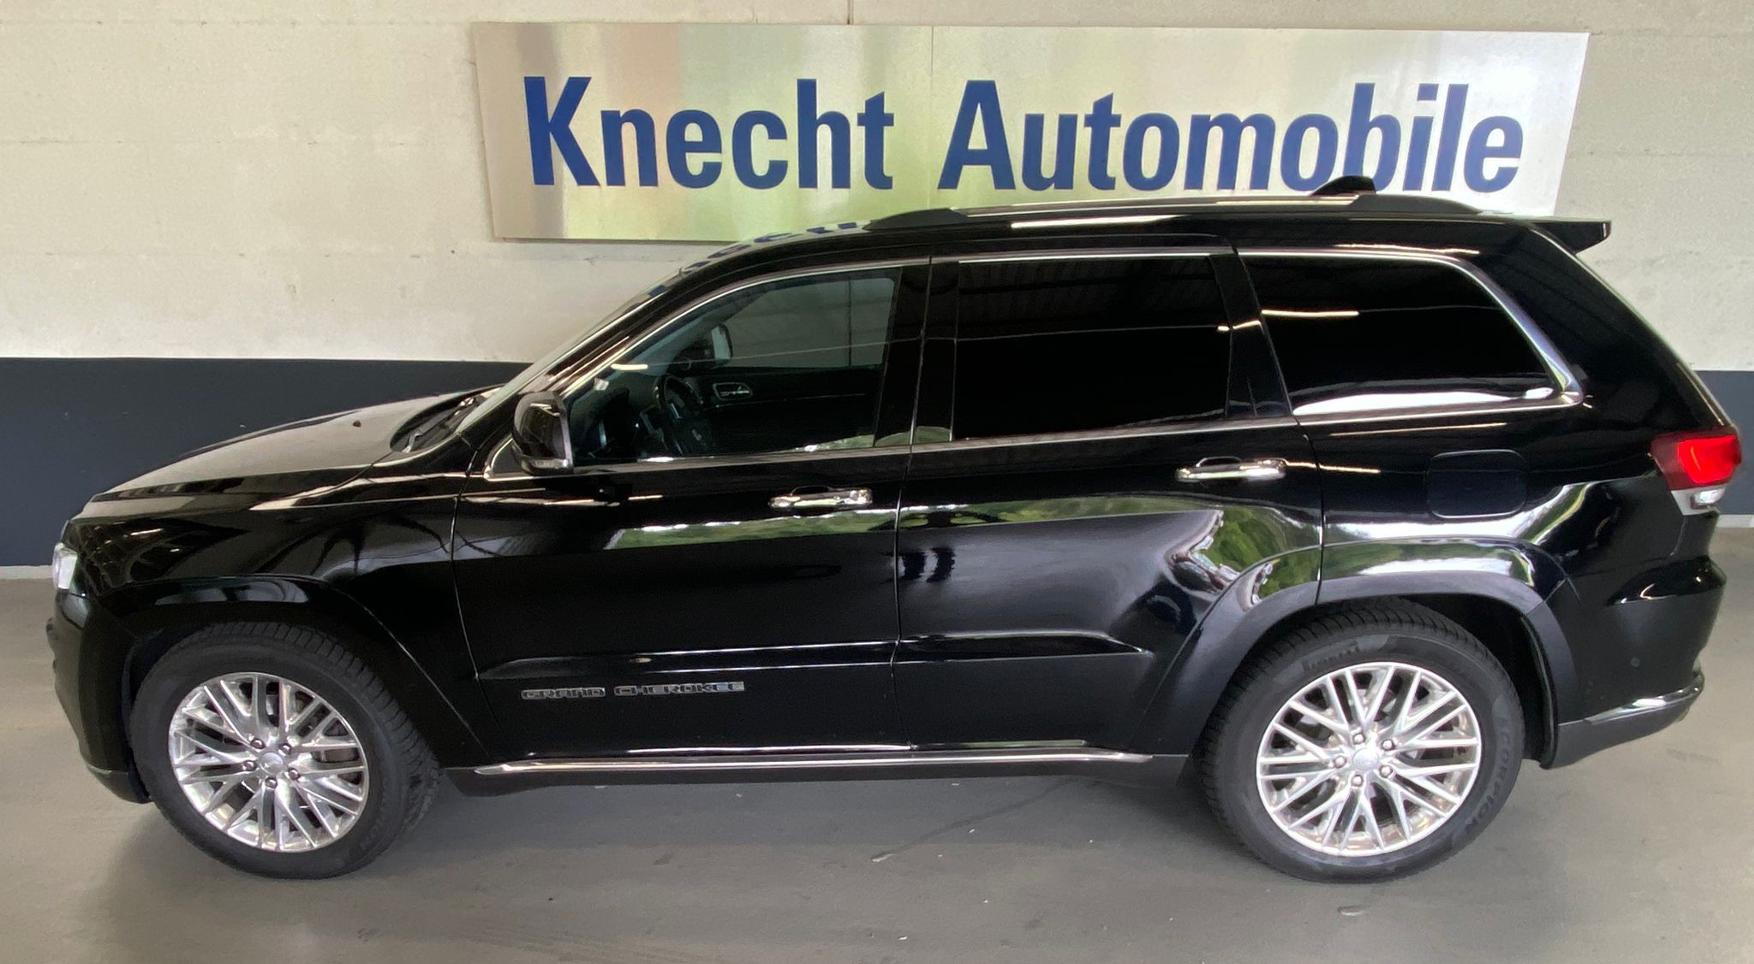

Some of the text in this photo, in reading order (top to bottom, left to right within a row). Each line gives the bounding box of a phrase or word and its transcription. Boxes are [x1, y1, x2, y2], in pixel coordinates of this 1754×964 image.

[523, 75, 1524, 193] Knecht Automobile
[522, 681, 745, 700] GRAND CHEROKEE
